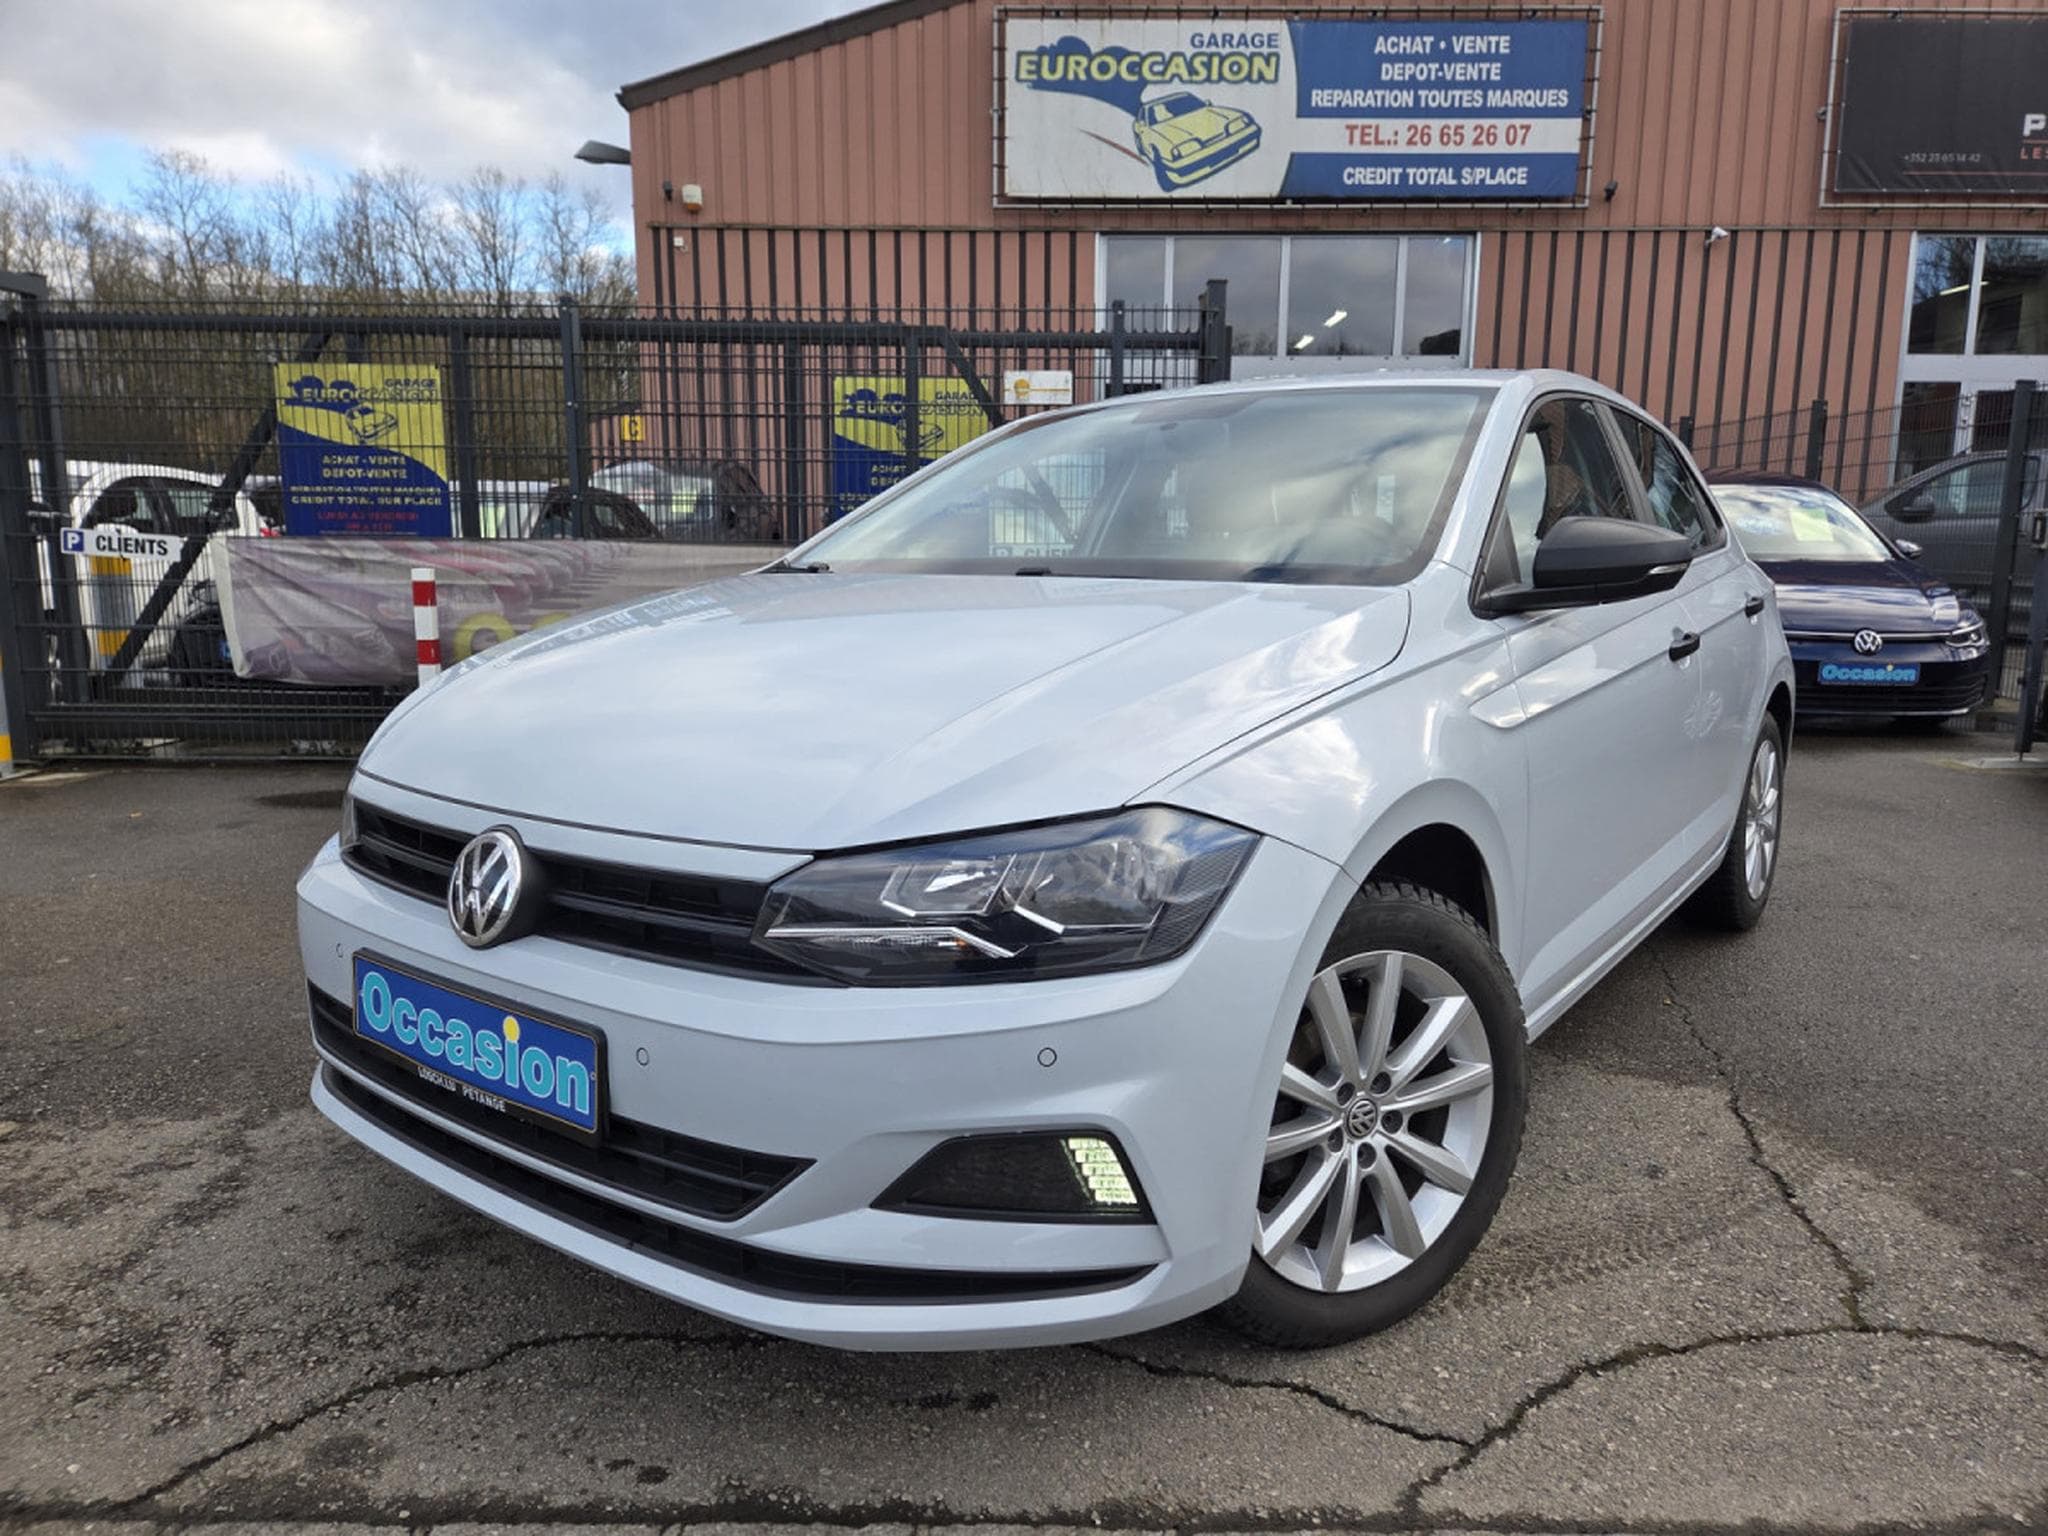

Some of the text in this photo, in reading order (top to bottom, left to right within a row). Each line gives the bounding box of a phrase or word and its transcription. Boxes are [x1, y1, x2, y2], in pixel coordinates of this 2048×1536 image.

[1189, 32, 1280, 49] GARAGE
[1374, 36, 1511, 54] ACHAT VENTE
[1014, 51, 1281, 83] EUROCCASION
[1380, 62, 1502, 82] DEPOT-VENTE
[1311, 89, 1569, 110] REPARATION TOUTES MARQUES
[1405, 124, 1434, 147] 26
[1438, 124, 1466, 147] 65
[1471, 124, 1499, 147] 26
[1504, 124, 1532, 147] 07
[1343, 167, 1528, 187] CREDIT TOTAL S/PLACE
[95, 534, 168, 556] CLIENTS
[1821, 662, 1917, 682] Occasion
[362, 971, 589, 1115] Occasion
